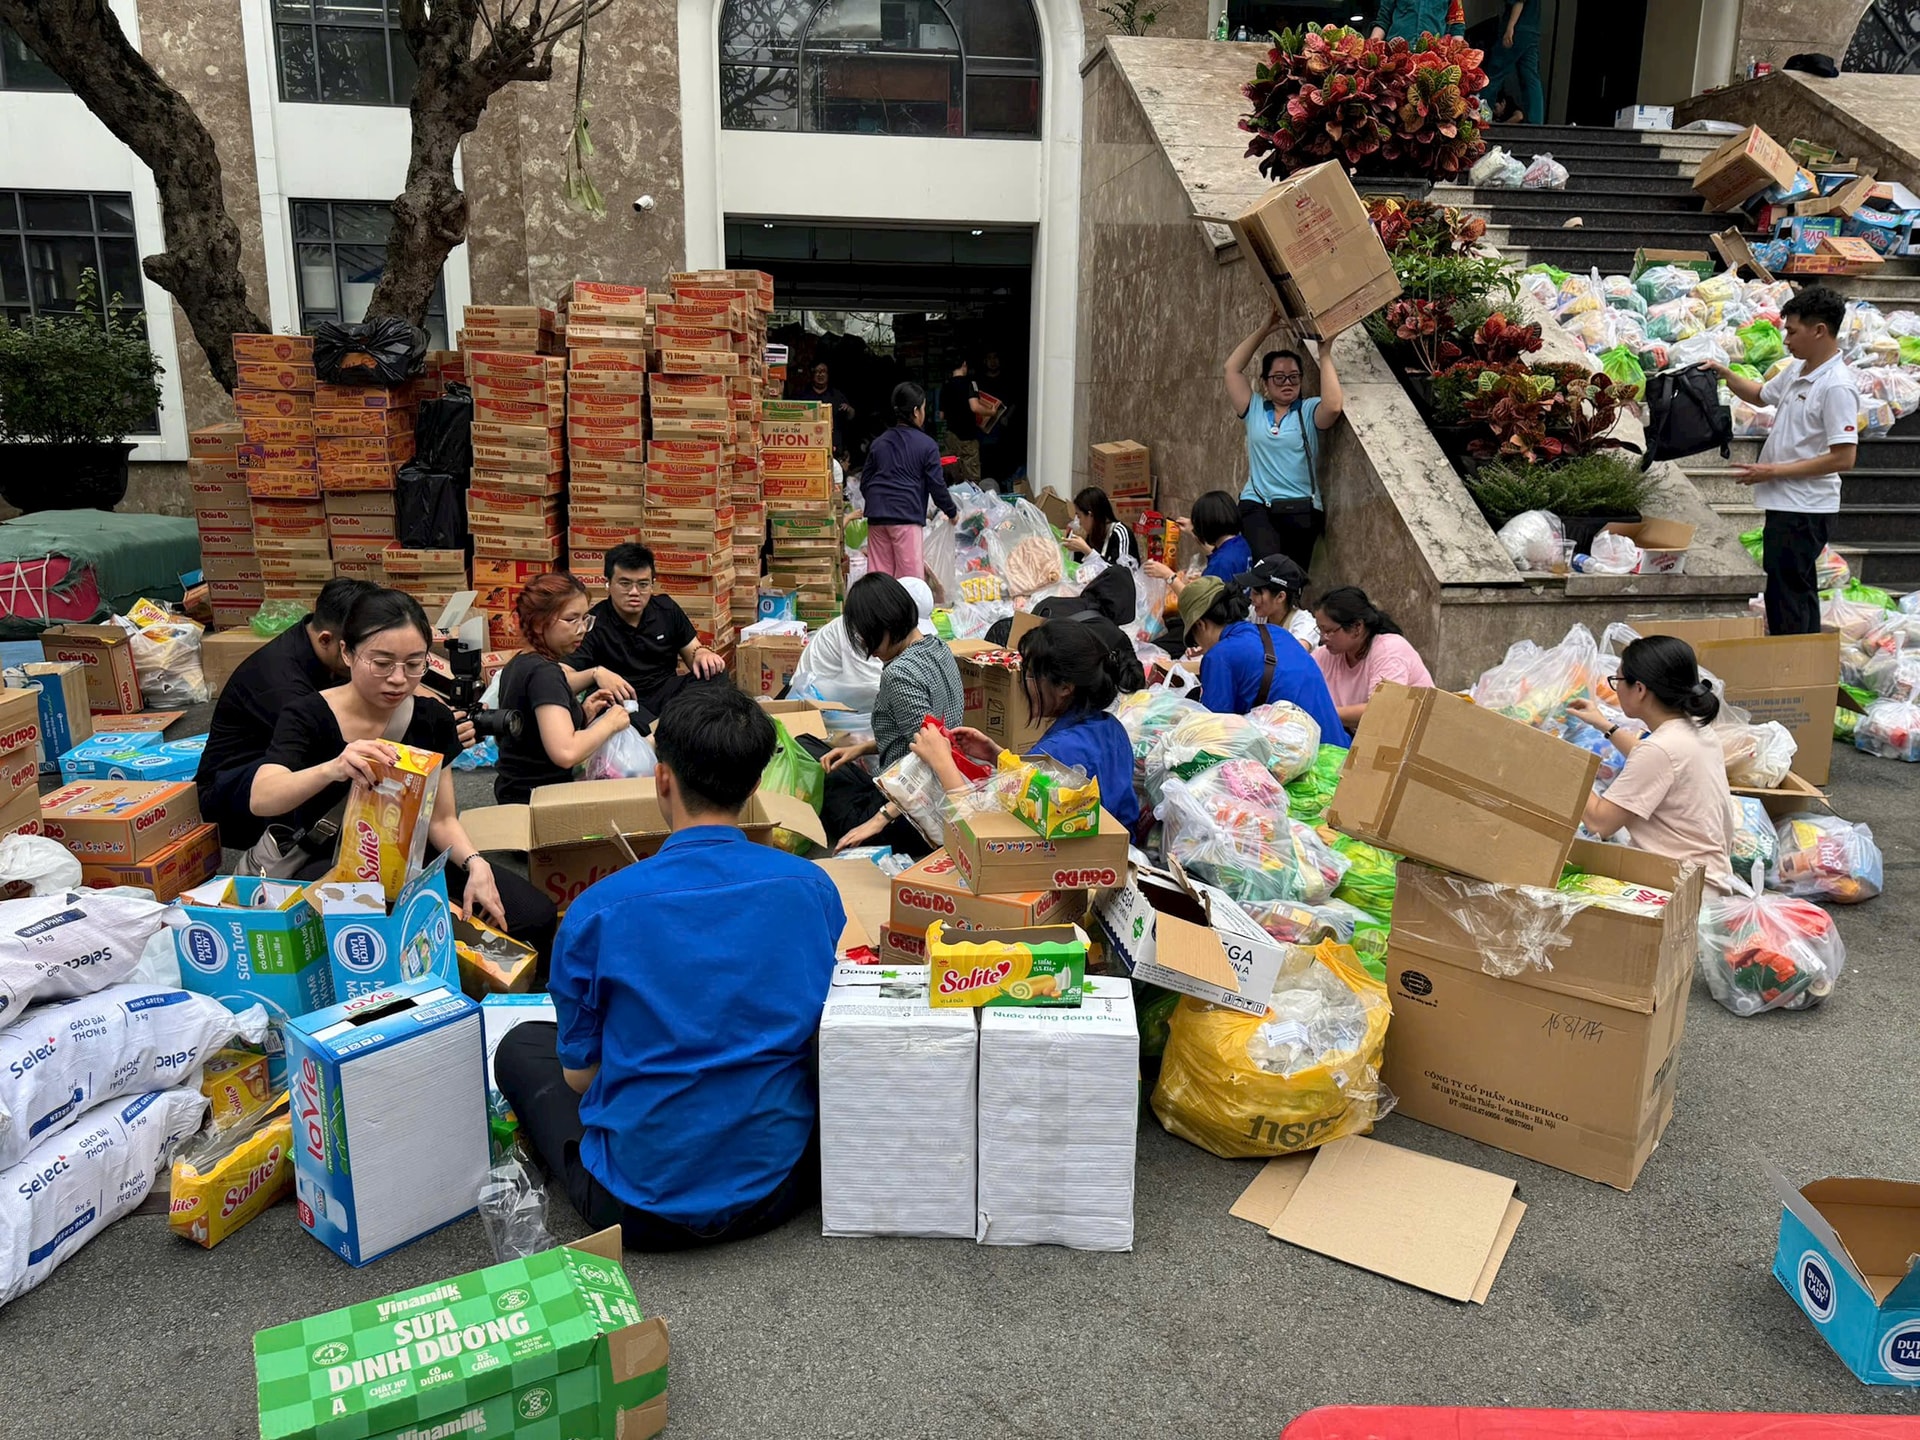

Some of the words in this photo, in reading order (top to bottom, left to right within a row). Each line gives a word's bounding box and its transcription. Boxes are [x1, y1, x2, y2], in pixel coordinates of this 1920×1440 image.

[762, 435, 808, 445] VIFON
[140, 606, 165, 622] Solite
[137, 811, 154, 830] Gấu
[155, 806, 166, 821] Đỏ
[357, 831, 381, 882] Solite
[1054, 869, 1076, 887] Đỏ
[1077, 868, 1116, 887] Gấu
[898, 887, 932, 910] Gấu
[933, 893, 955, 914] Đỏ
[47, 915, 65, 927] PHÁT
[36, 937, 42, 945] 5
[43, 934, 55, 942] kg
[194, 932, 206, 961] DUTCH
[229, 922, 245, 950] Tươi
[204, 938, 213, 959] LADY
[349, 938, 361, 962] LADY
[358, 935, 369, 963] DUTCH
[238, 955, 250, 980] Sữa
[940, 968, 999, 993] Solite
[130, 1000, 144, 1009] KING
[146, 997, 165, 1005] GREEN
[70, 1018, 90, 1031] GẠO
[141, 1013, 149, 1021] kg
[1028, 1012, 1058, 1021] uống
[72, 1028, 100, 1042] THƠM
[102, 1027, 107, 1035] 8
[10, 1039, 57, 1079] Select
[225, 1087, 242, 1116] Solite
[1424, 1070, 1449, 1084] CÔNG
[1451, 1079, 1462, 1088] TY
[1508, 1098, 1569, 1122] ARMEPHACO
[126, 1103, 141, 1117] KING
[1498, 1104, 1514, 1116] Long
[136, 1117, 147, 1129] kg
[79, 1135, 97, 1149] GẠO
[85, 1143, 109, 1159] THƠM
[18, 1160, 70, 1200] Select
[221, 1161, 275, 1217] Solite
[1807, 1268, 1829, 1298] DUTCH
[1808, 1280, 1826, 1303] LADY
[376, 1284, 461, 1317] Vinamilk
[393, 1308, 458, 1345] SỮA
[328, 1347, 412, 1392] DINH
[415, 1312, 530, 1366] DƯỠNG
[429, 1367, 441, 1377] CÓ
[369, 1380, 393, 1397] CHẤT
[331, 1398, 348, 1416] A
